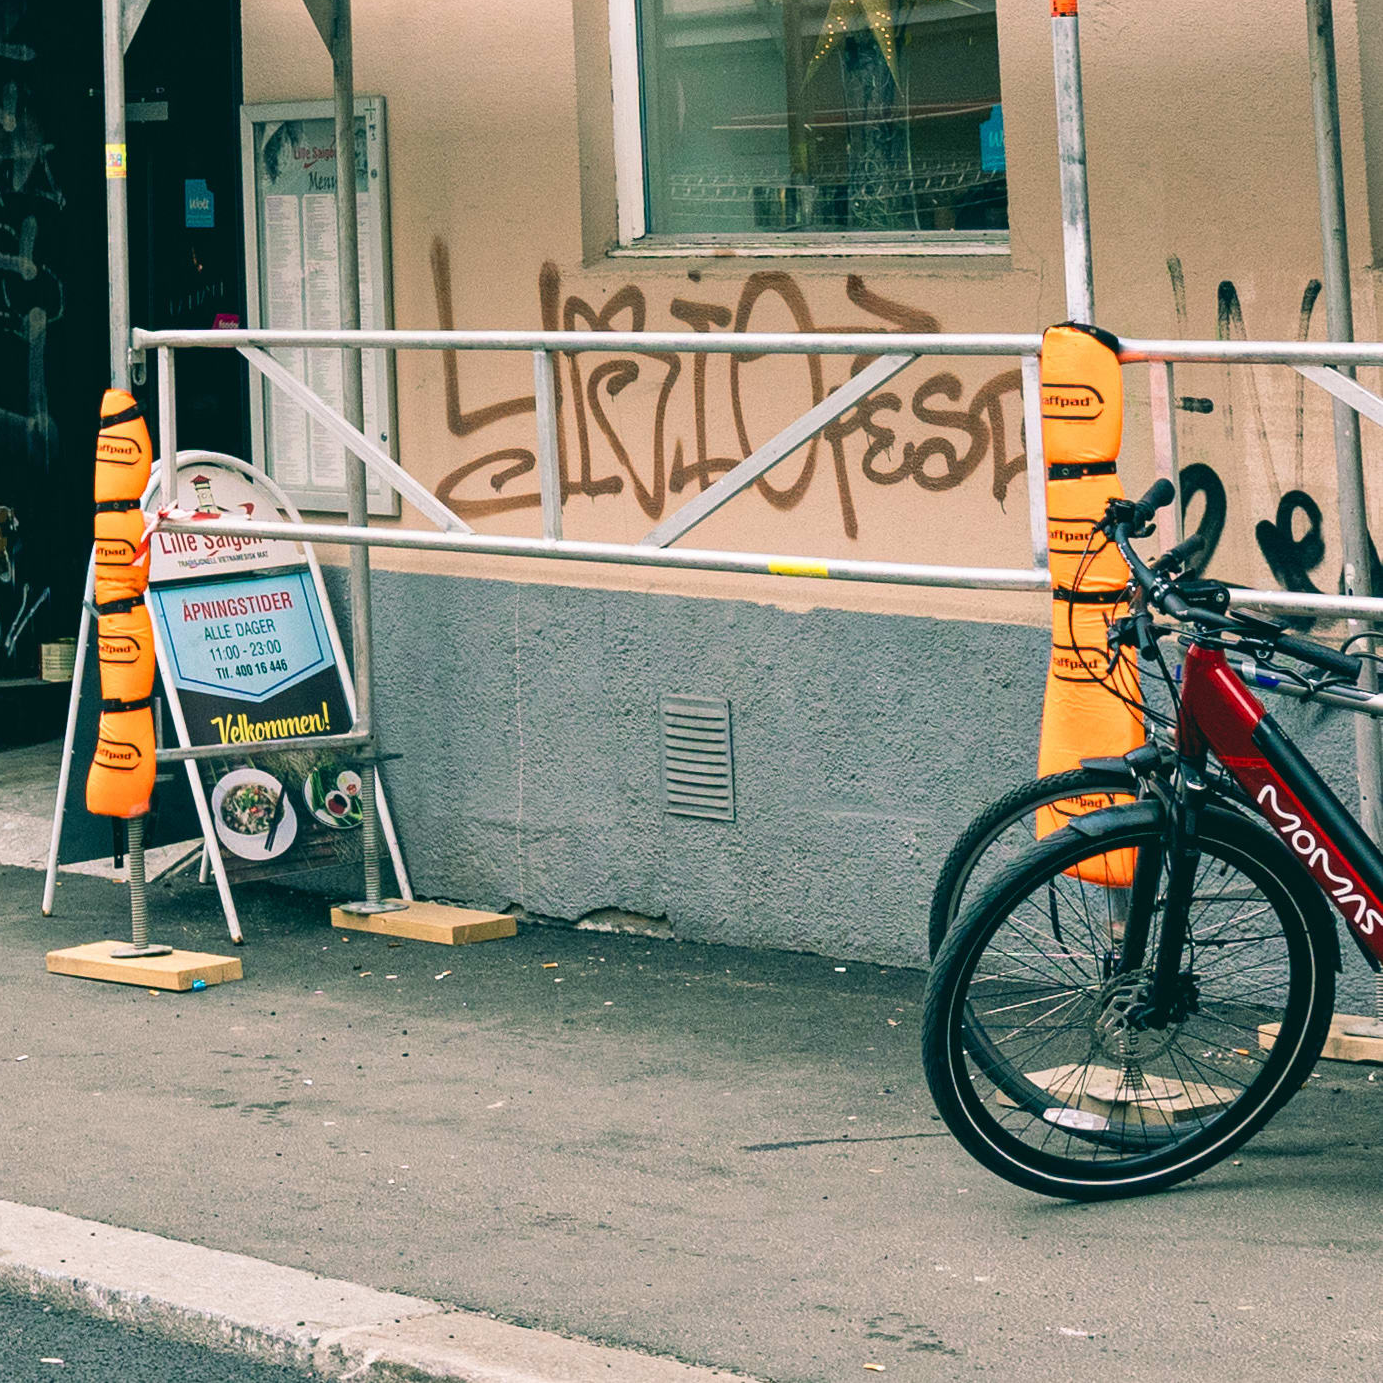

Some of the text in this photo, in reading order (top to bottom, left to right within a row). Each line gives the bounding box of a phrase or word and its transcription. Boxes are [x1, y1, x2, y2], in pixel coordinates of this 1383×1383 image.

[312, 145, 337, 160] Saigo
[1043, 396, 1091, 407] affpad
[159, 532, 199, 555] Lille
[182, 591, 294, 622] ÅPNINGSTIDER
[204, 618, 276, 641] ALLE DAGER
[209, 644, 240, 662] 11:00
[250, 639, 282, 657] 23:00
[235, 663, 254, 677] 400
[256, 662, 267, 674] 16
[270, 659, 288, 672] 446
[211, 701, 330, 744] Velkommen!
[1256, 783, 1383, 936] MOMAS
